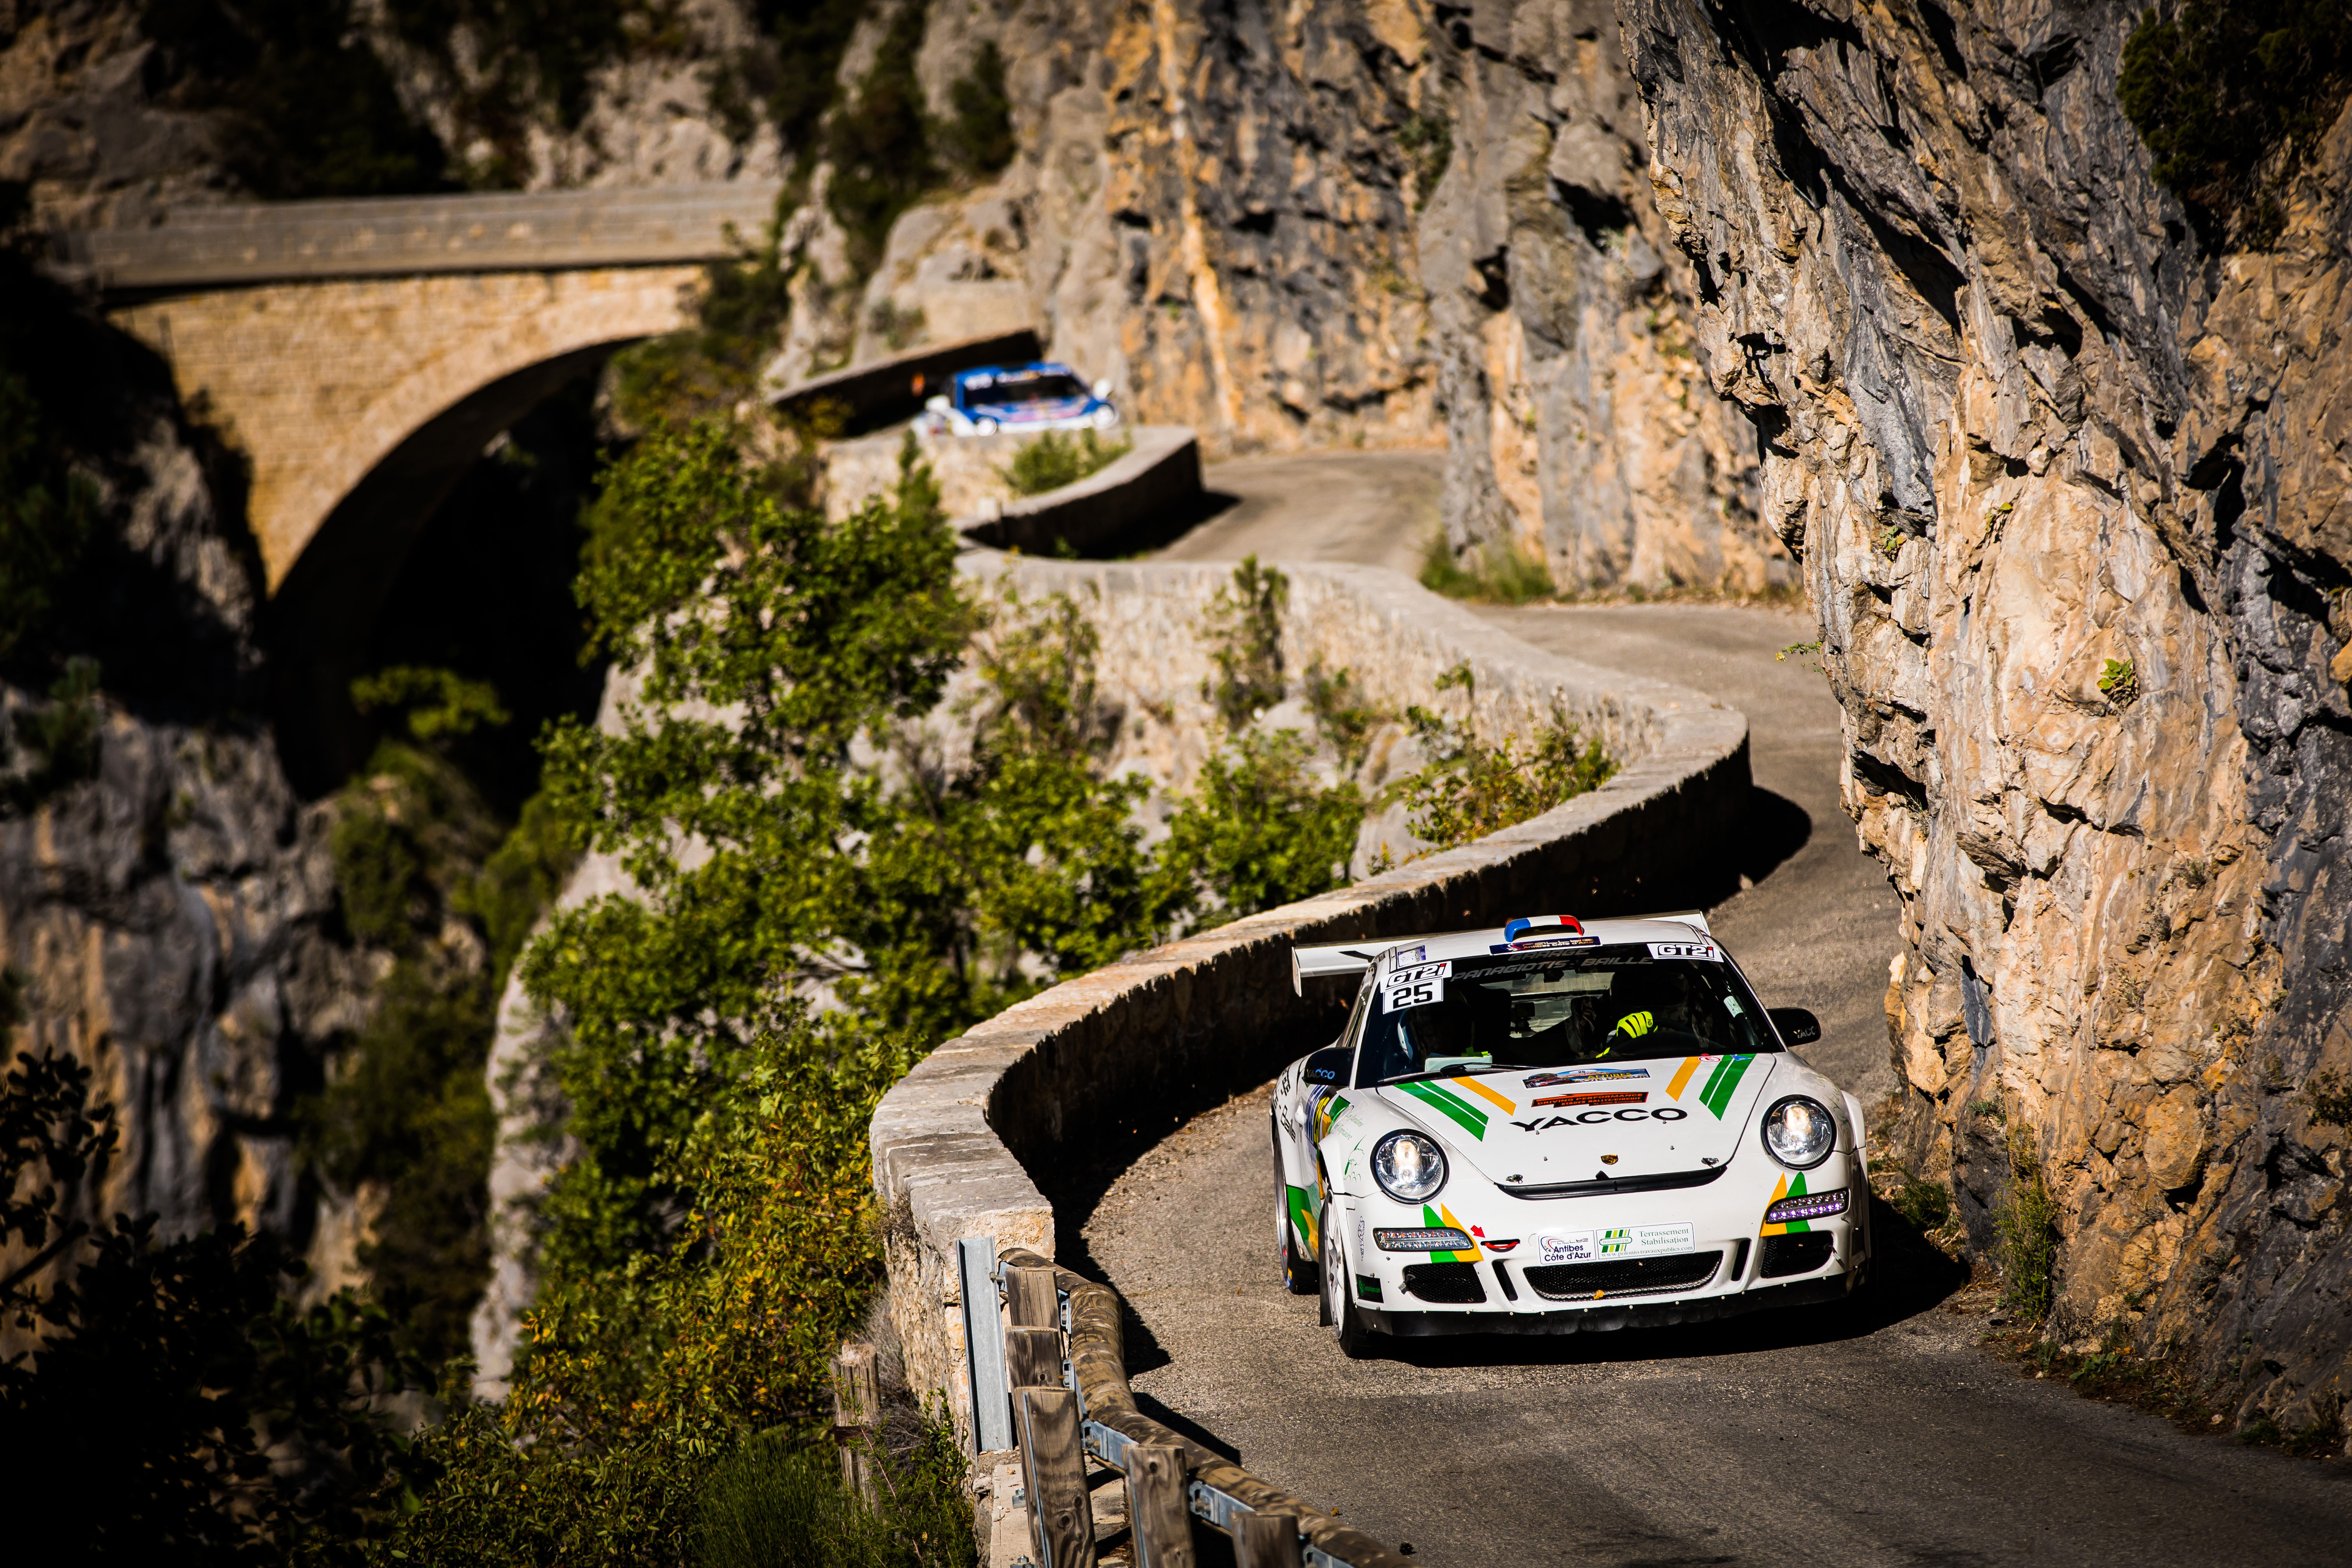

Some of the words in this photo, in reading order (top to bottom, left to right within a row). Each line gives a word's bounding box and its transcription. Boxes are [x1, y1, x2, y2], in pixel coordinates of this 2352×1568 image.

[1508, 948, 1593, 961] GARAGE
[1657, 944, 1714, 958] GT2i
[1386, 963, 1447, 988] GT2i
[1450, 960, 1570, 982] PANAGIOTIS
[1581, 957, 1655, 966] BAILLE
[1393, 982, 1433, 1009] 25
[1793, 1026, 1819, 1038] YACC
[1307, 1069, 1335, 1080] YACCO
[1508, 1108, 1688, 1132] YACCO
[1638, 1228, 1689, 1237] Terrassement
[1642, 1236, 1688, 1245] Stabilisation
[1554, 1245, 1584, 1253] Antibes
[1602, 1246, 1693, 1257] www.polonio-travauxpublics.com
[1567, 1252, 1591, 1260] d'Azur
